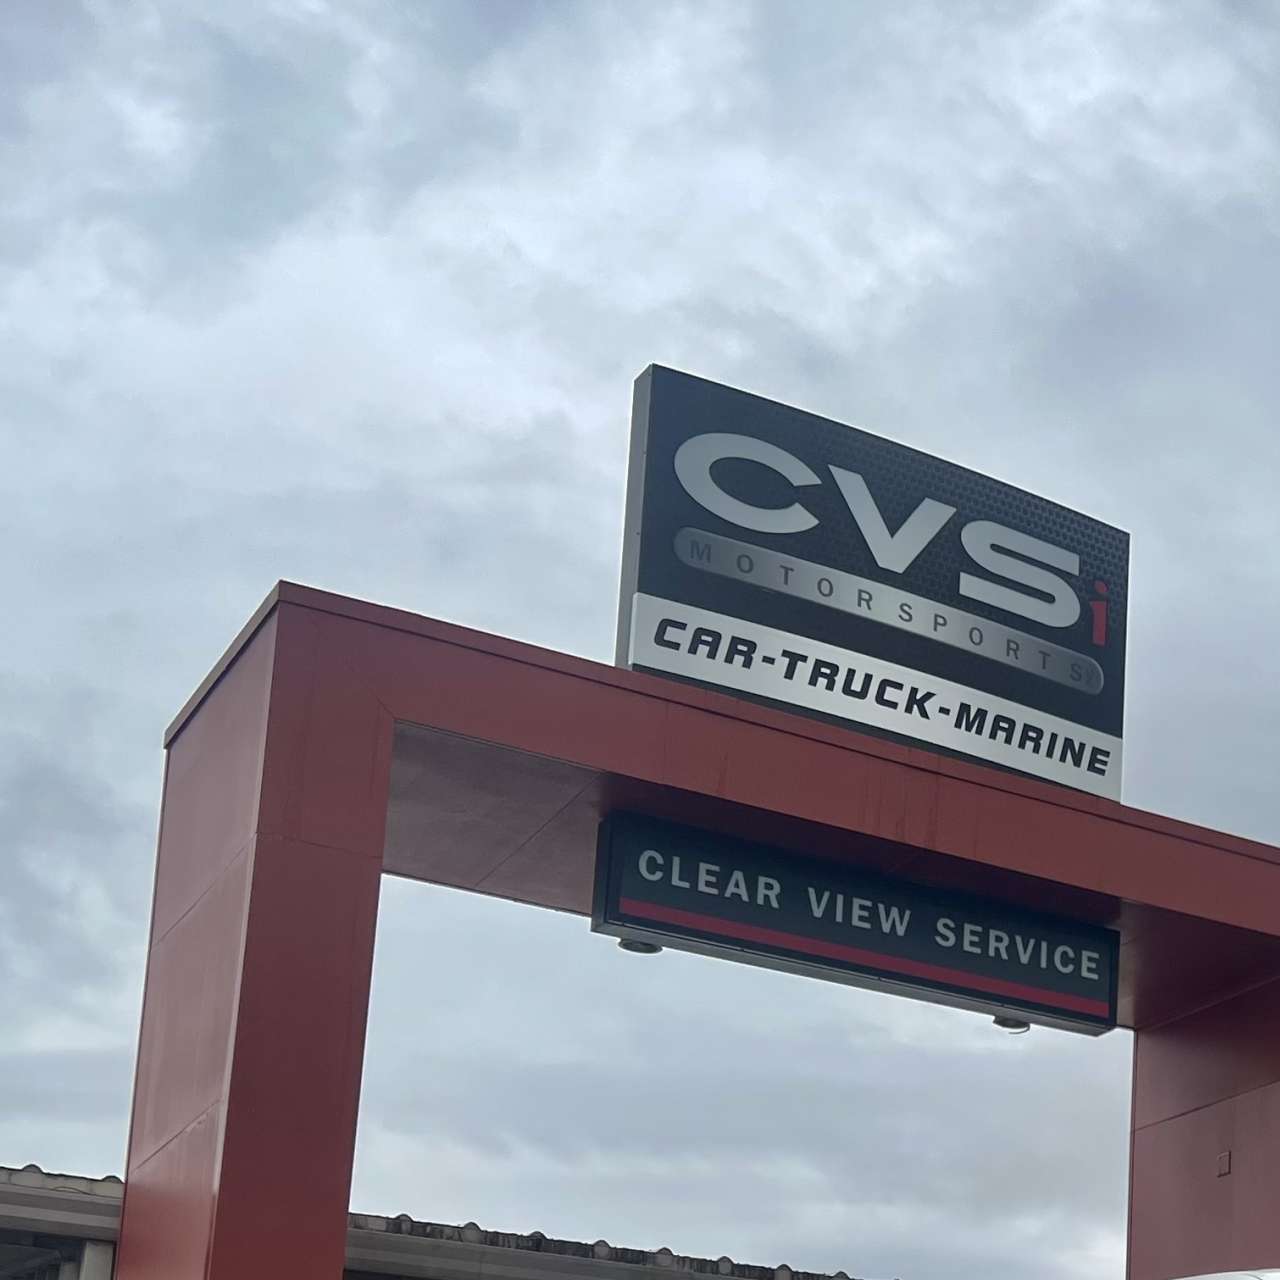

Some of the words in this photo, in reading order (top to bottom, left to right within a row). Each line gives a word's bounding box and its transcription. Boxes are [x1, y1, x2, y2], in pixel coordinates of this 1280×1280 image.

[689, 538, 1082, 682] MOTORSPORTS
[653, 617, 1111, 777] CAR-TRUCK-MARINE
[638, 849, 781, 908] CLEAR
[807, 887, 912, 937] VIEW
[934, 917, 1100, 980] SERVICE
